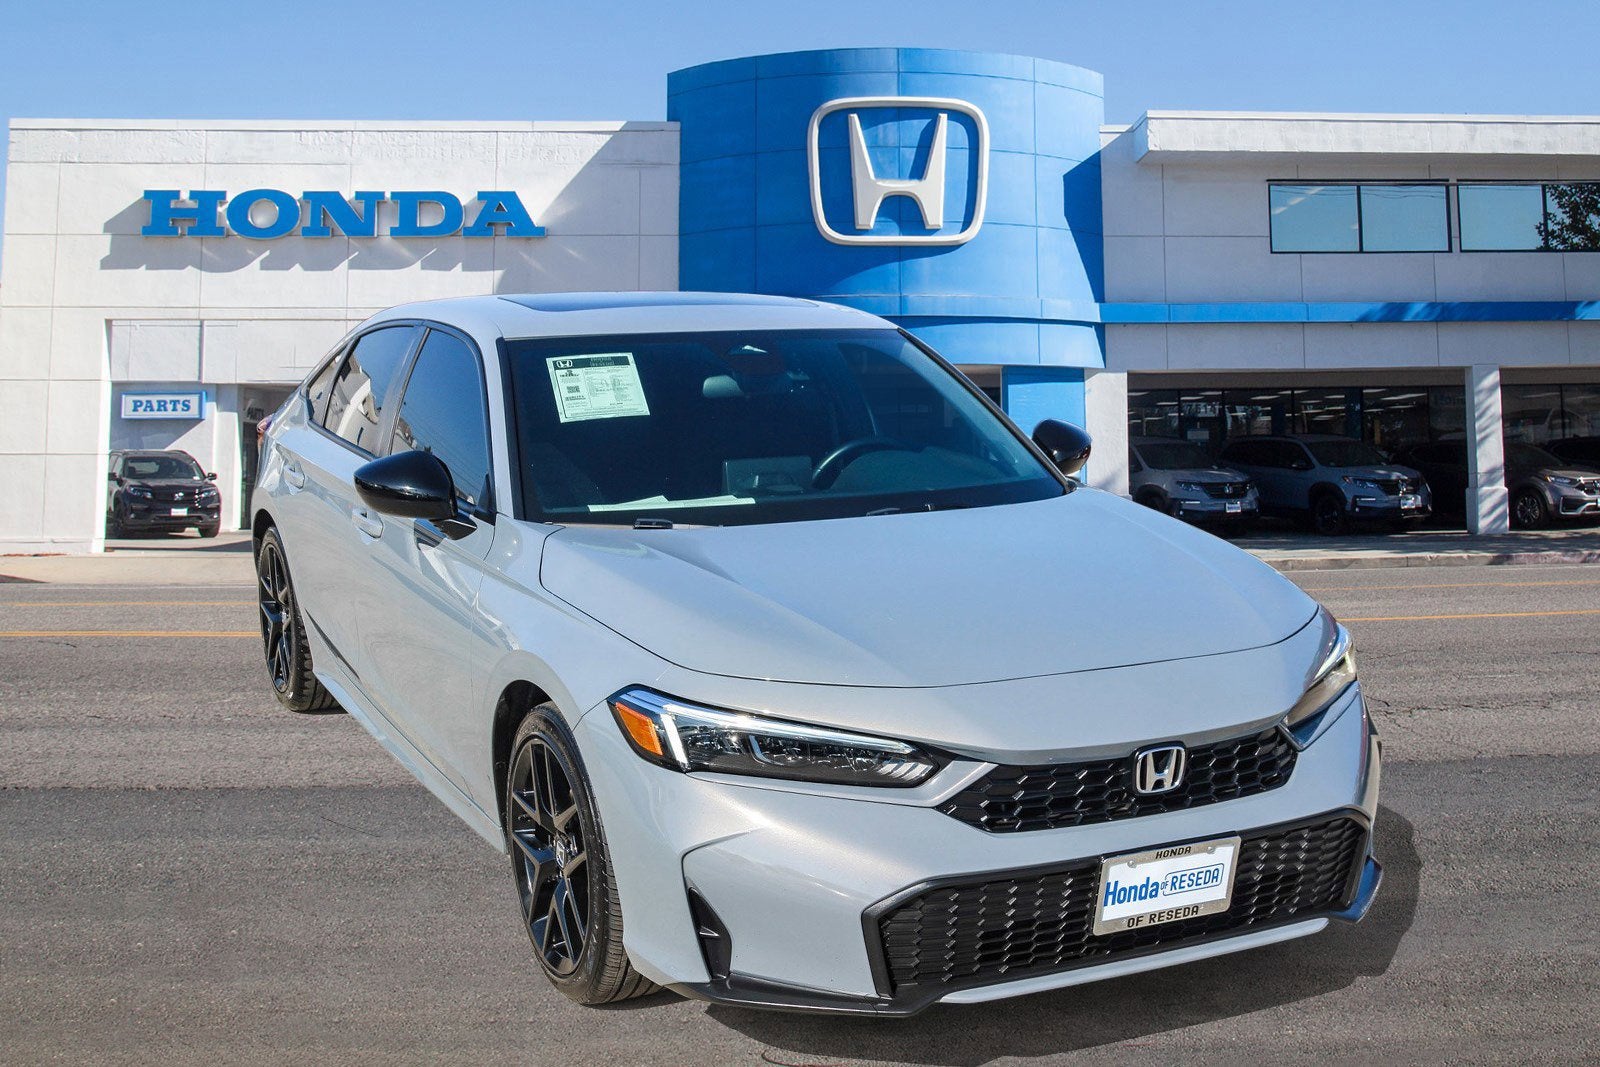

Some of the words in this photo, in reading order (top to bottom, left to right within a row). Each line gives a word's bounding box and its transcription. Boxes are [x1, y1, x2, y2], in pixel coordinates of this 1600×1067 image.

[141, 189, 547, 239] HONDA
[132, 399, 191, 412] PARTS
[1155, 846, 1192, 859] HONDA
[1103, 876, 1160, 907] Honda
[1160, 880, 1169, 891] OF
[1169, 867, 1220, 891] RESEDA
[1127, 915, 1143, 928] OF
[1148, 905, 1199, 925] RESEDA
